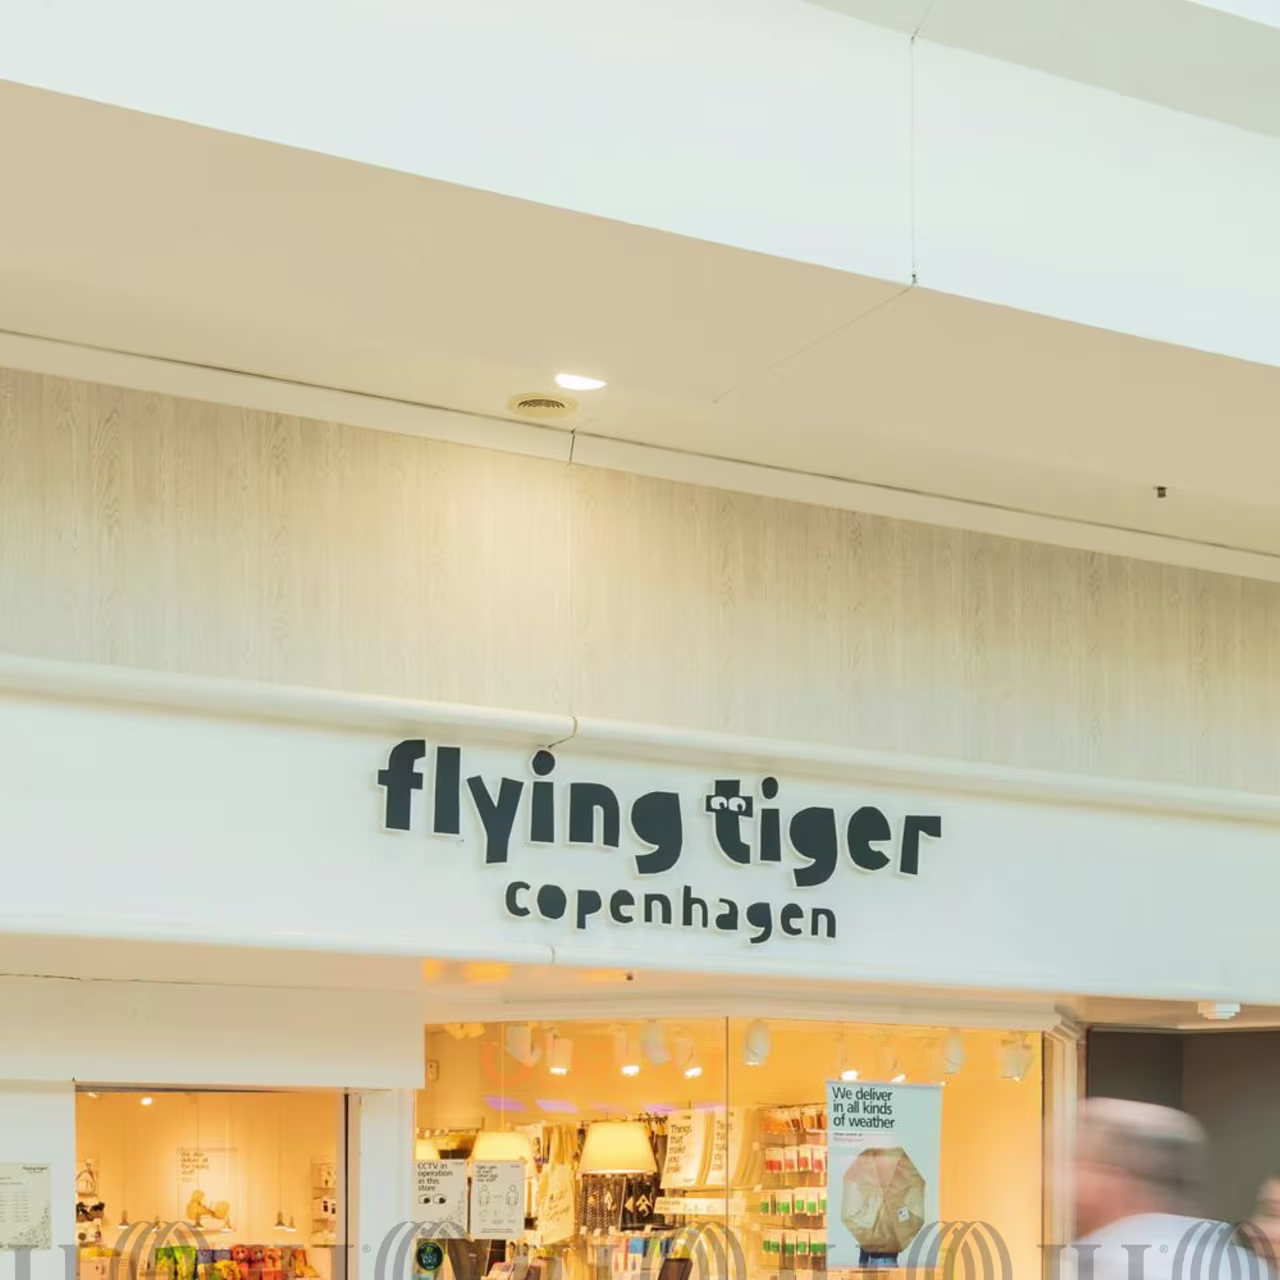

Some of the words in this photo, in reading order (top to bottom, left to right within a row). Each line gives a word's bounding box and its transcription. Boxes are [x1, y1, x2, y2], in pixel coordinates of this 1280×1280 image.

[377, 738, 684, 875] flying
[704, 776, 942, 888] tiger
[505, 879, 837, 944] copenhagen
[832, 1087, 852, 1099] We
[856, 1087, 893, 1101] deliver
[833, 1100, 844, 1113] in
[847, 1101, 859, 1113] all
[863, 1101, 893, 1115] kinds
[833, 1114, 845, 1126] of
[849, 1115, 895, 1128] weather
[418, 1169, 453, 1177] operation
[418, 1184, 435, 1192] store
[427, 1177, 439, 1185] this
